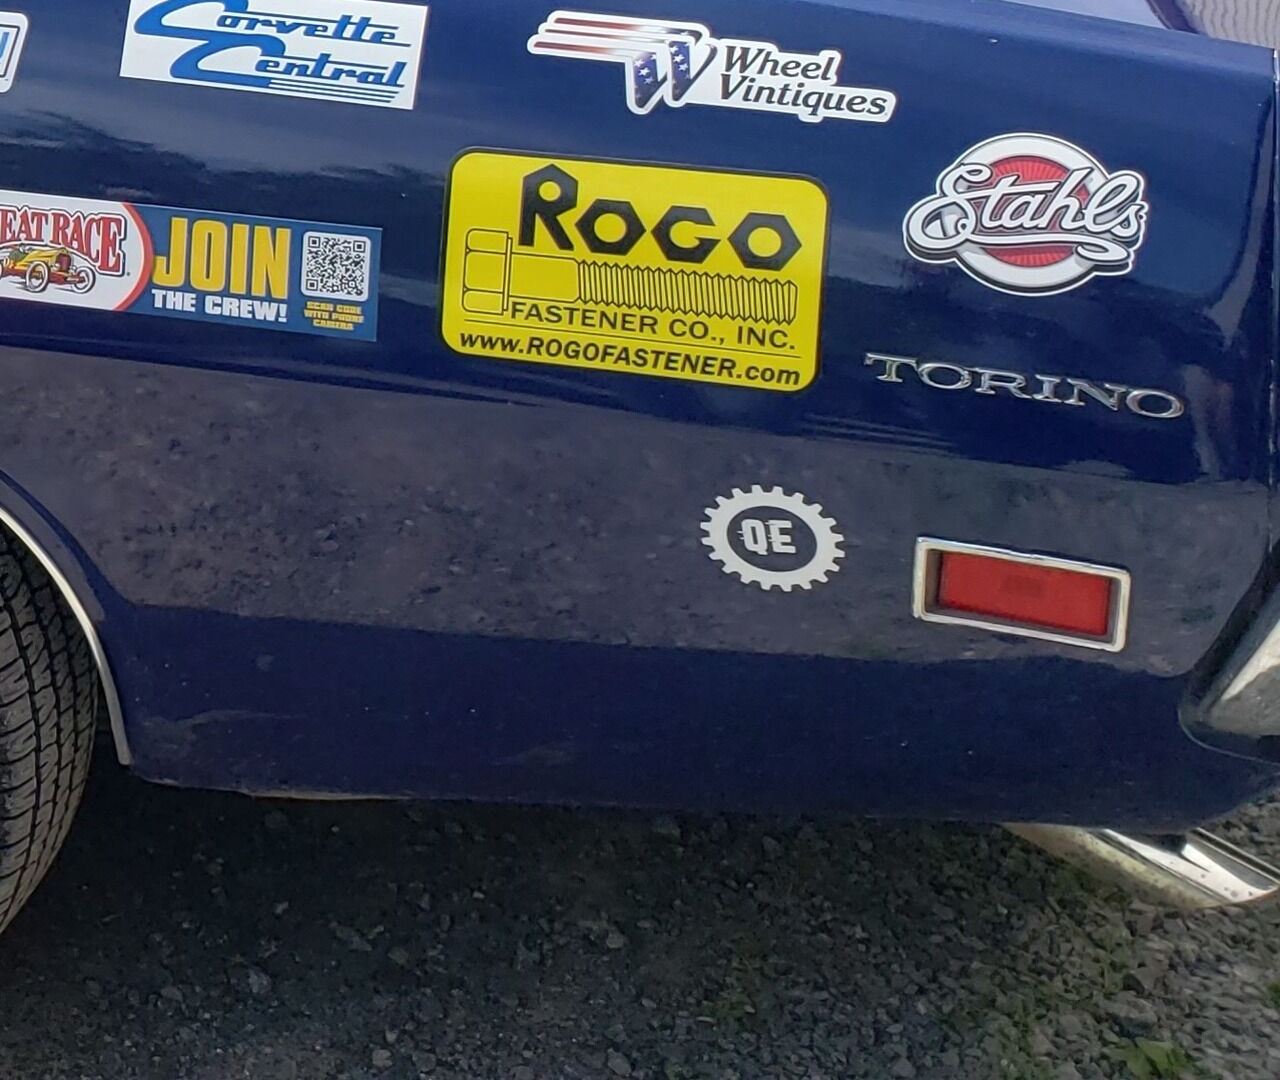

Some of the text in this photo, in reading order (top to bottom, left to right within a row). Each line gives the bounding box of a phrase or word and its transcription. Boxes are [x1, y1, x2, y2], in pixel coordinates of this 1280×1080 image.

[170, 34, 405, 88] Central
[724, 45, 837, 81] Wheel
[719, 73, 888, 116] Vintiques
[51, 210, 125, 274] RACE
[517, 163, 803, 272] ROGO
[152, 217, 292, 299] JOIN
[151, 288, 288, 323] THE CREW!
[509, 301, 797, 351] FASTENER CO., INC.
[459, 332, 801, 386] www.ROGOFASTENER.com
[864, 352, 1185, 418] TORINO
[738, 518, 797, 556] QE
